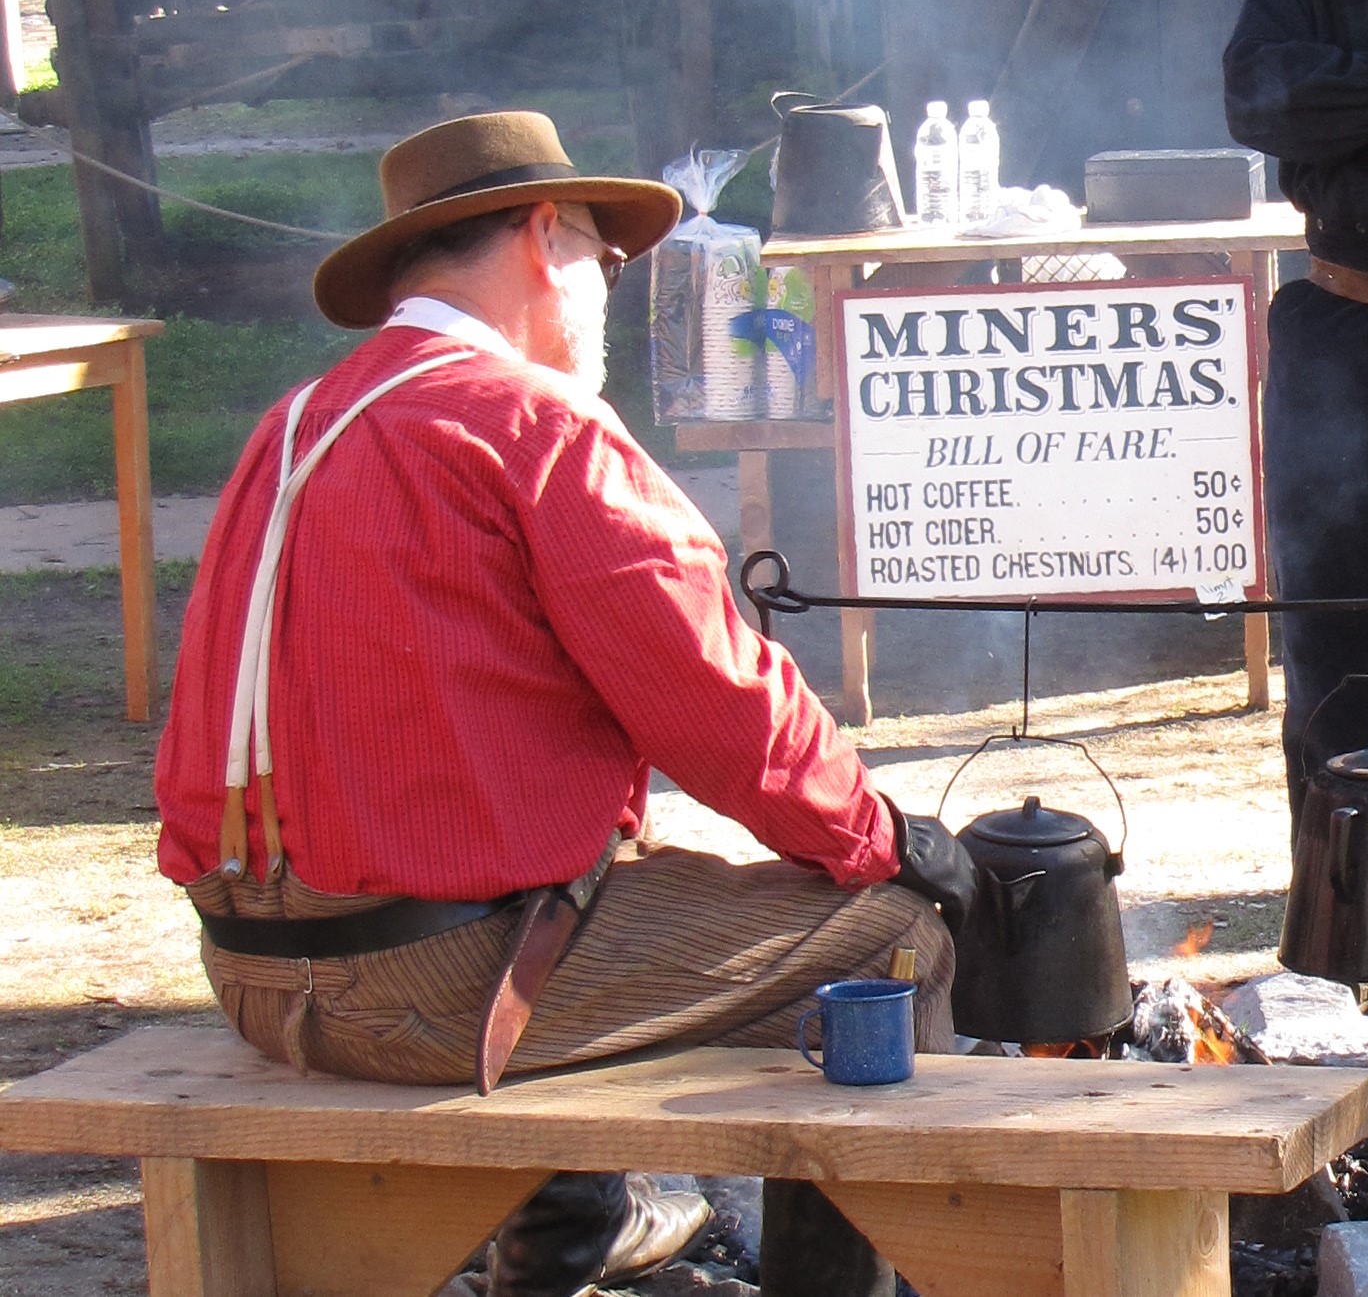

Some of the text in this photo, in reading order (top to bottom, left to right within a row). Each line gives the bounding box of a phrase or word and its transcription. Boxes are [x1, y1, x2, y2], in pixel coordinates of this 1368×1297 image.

[859, 298, 1236, 361] MINERS'
[859, 358, 1238, 420] CHRISTMAS.
[925, 427, 1178, 469] BILL OF FARE.
[866, 483, 912, 513] HOT
[1193, 470, 1242, 499] 50¢
[868, 520, 914, 550] HOT
[1196, 506, 1244, 535] 50¢
[870, 554, 981, 584] ROASTED
[1194, 543, 1248, 573] 1.00
